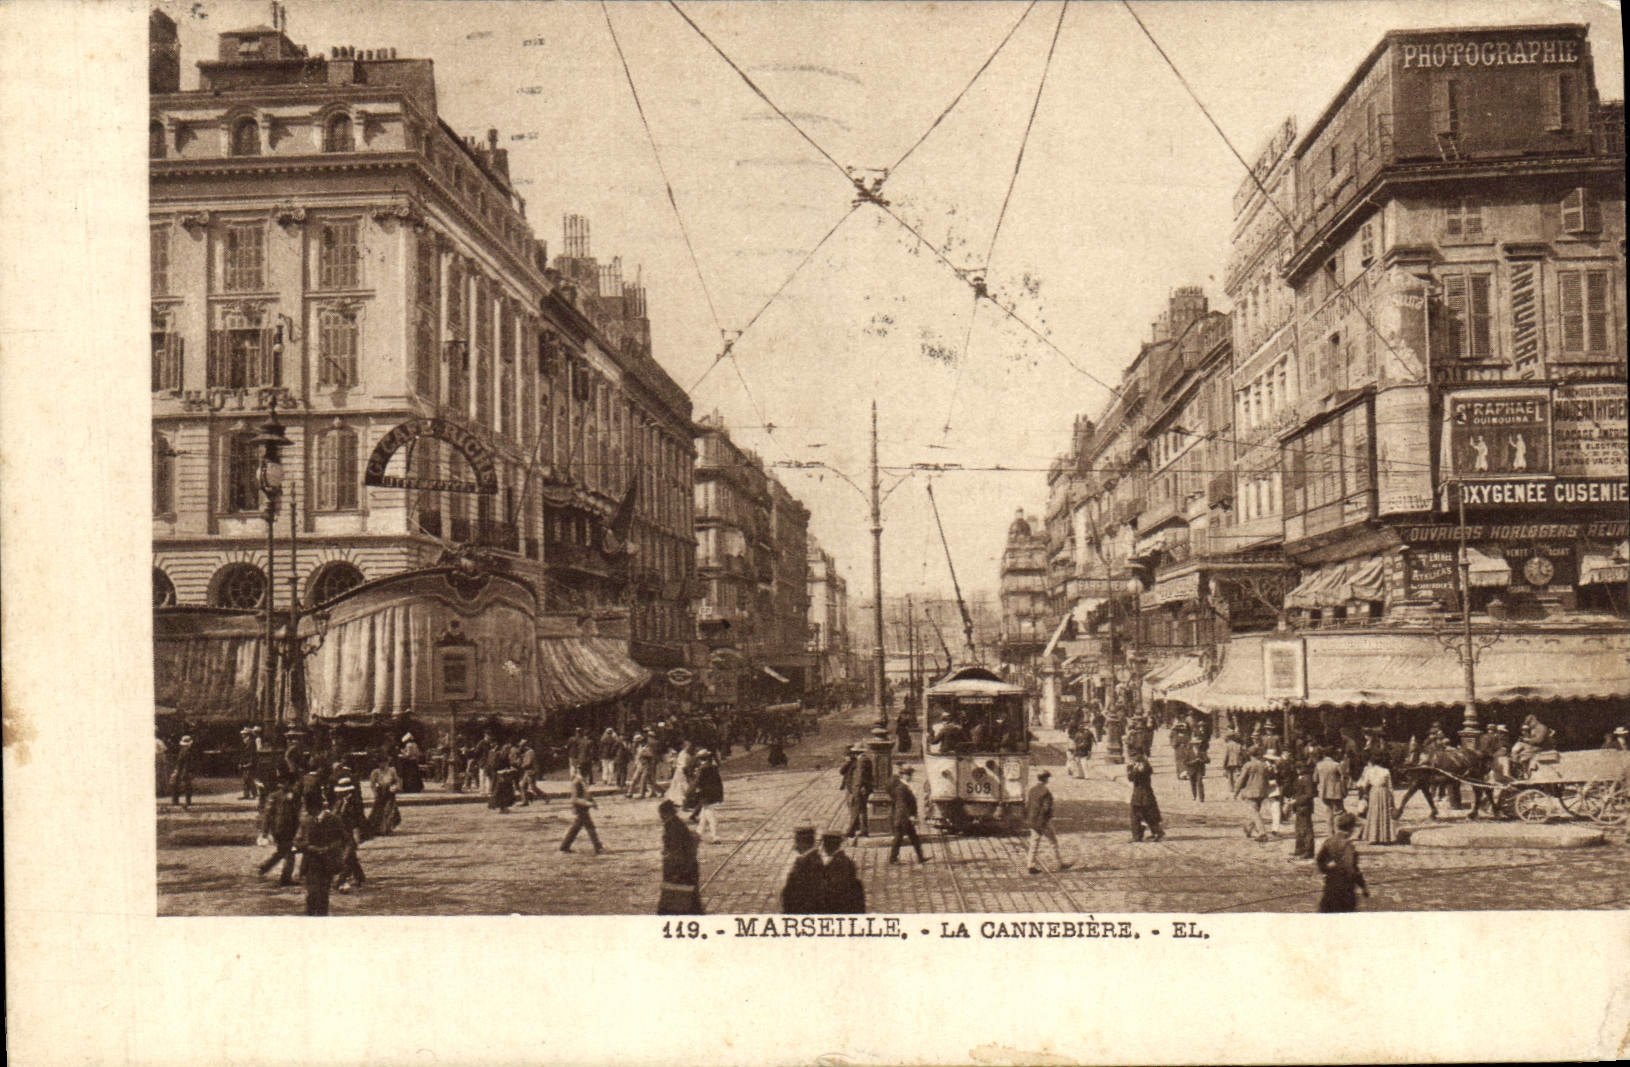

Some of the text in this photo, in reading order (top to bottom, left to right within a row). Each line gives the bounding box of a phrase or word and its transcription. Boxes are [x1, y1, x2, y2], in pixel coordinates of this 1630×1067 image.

[1402, 39, 1578, 69] PHOTOGRAPHIE
[1511, 263, 1539, 371] ANNUAIRE
[1554, 483, 1629, 503] CUSENIE
[1410, 526, 1483, 541] OUVRIERS
[1490, 524, 1580, 539] HORLOGERS
[966, 782, 992, 794] 509
